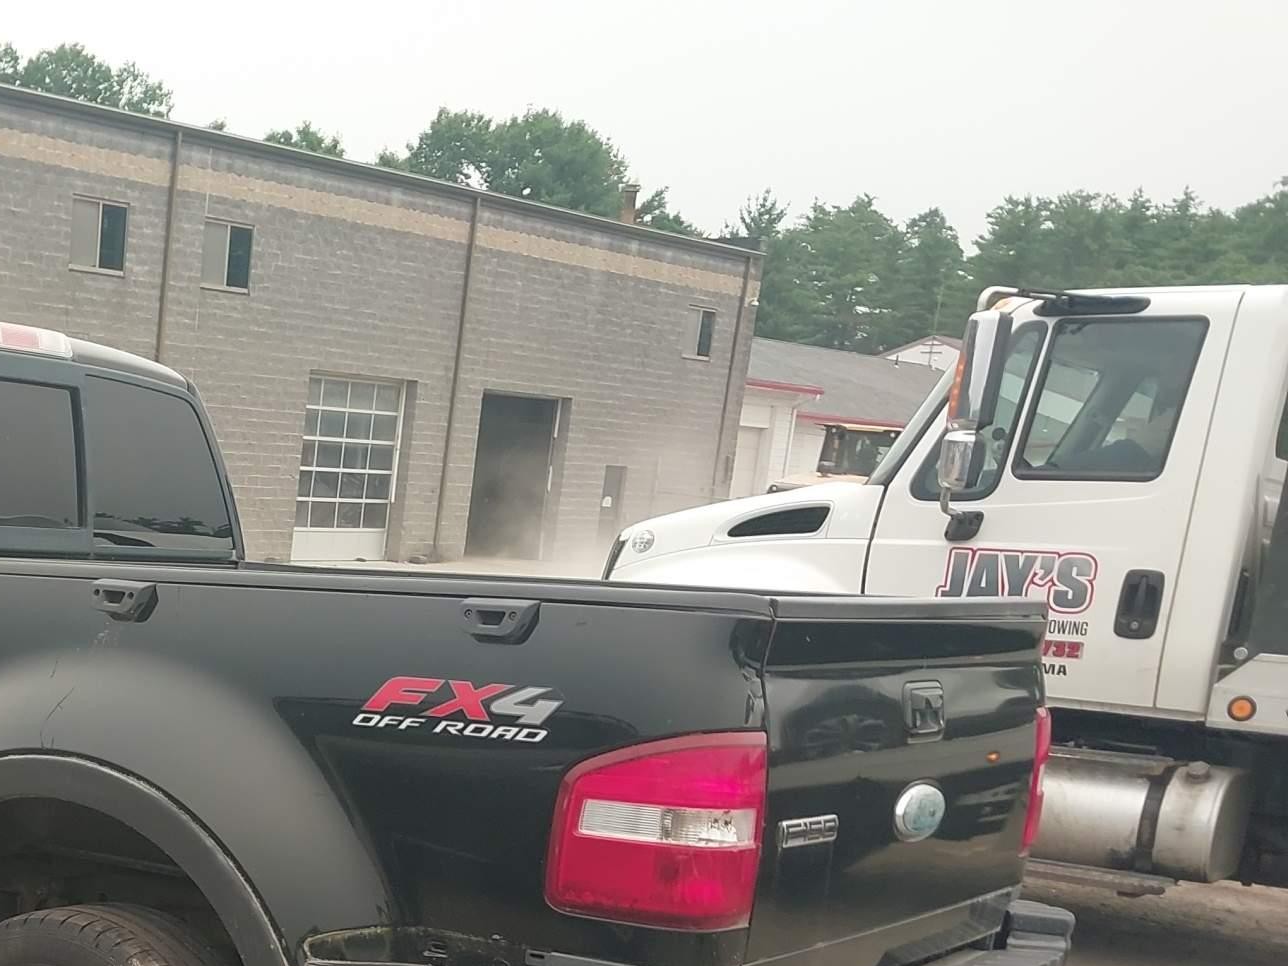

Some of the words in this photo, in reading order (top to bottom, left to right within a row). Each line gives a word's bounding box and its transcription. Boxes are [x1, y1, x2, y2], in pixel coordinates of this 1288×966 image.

[935, 547, 1098, 614] JAY'S
[361, 676, 564, 726] FX4
[352, 712, 427, 730] OFF
[432, 720, 549, 743] ROAD
